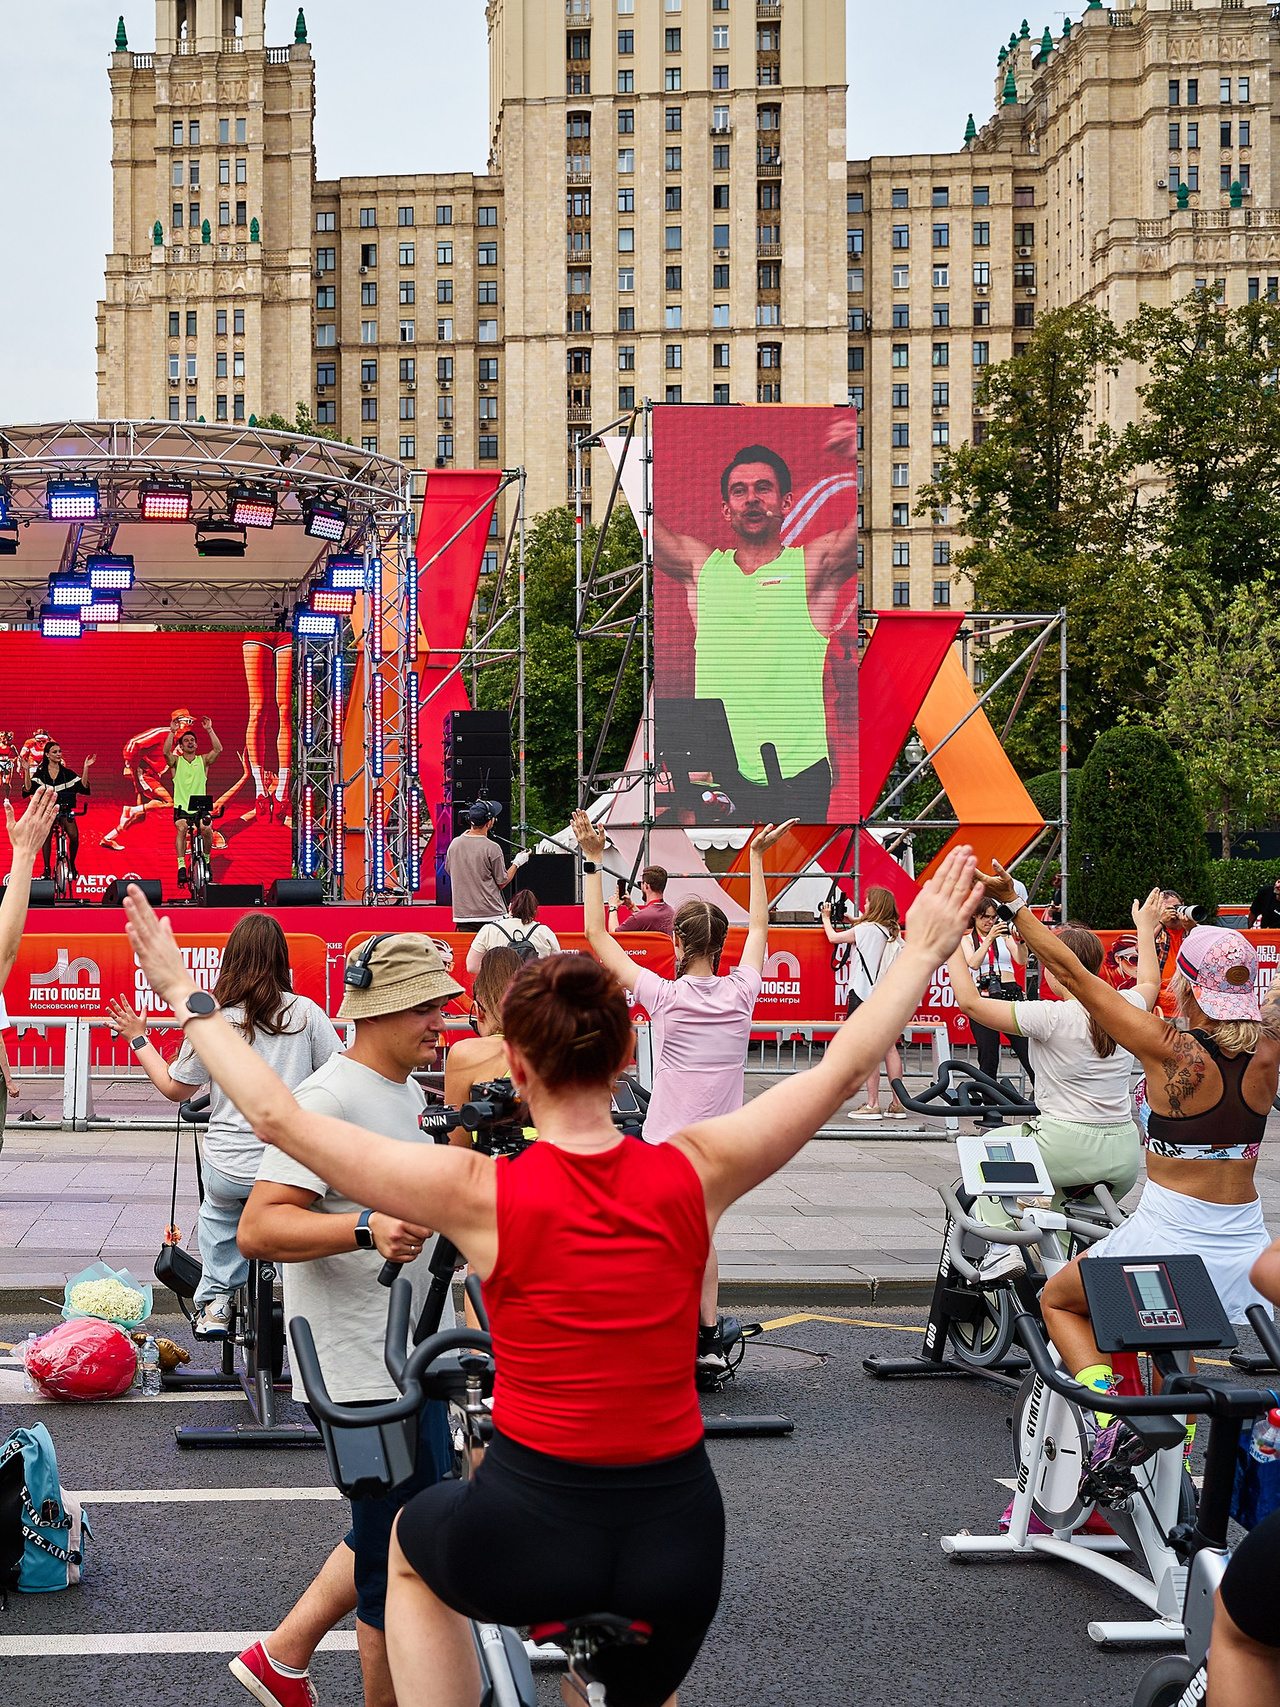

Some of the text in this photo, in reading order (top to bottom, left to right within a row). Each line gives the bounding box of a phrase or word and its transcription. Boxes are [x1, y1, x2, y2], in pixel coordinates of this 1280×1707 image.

[28, 988, 101, 1001] ЛЕТО ПОБЕД
[760, 981, 801, 995] ПОБЕД
[30, 1002, 101, 1011] Московские игры
[926, 1322, 937, 1349] 009
[1017, 1461, 1030, 1494] 008
